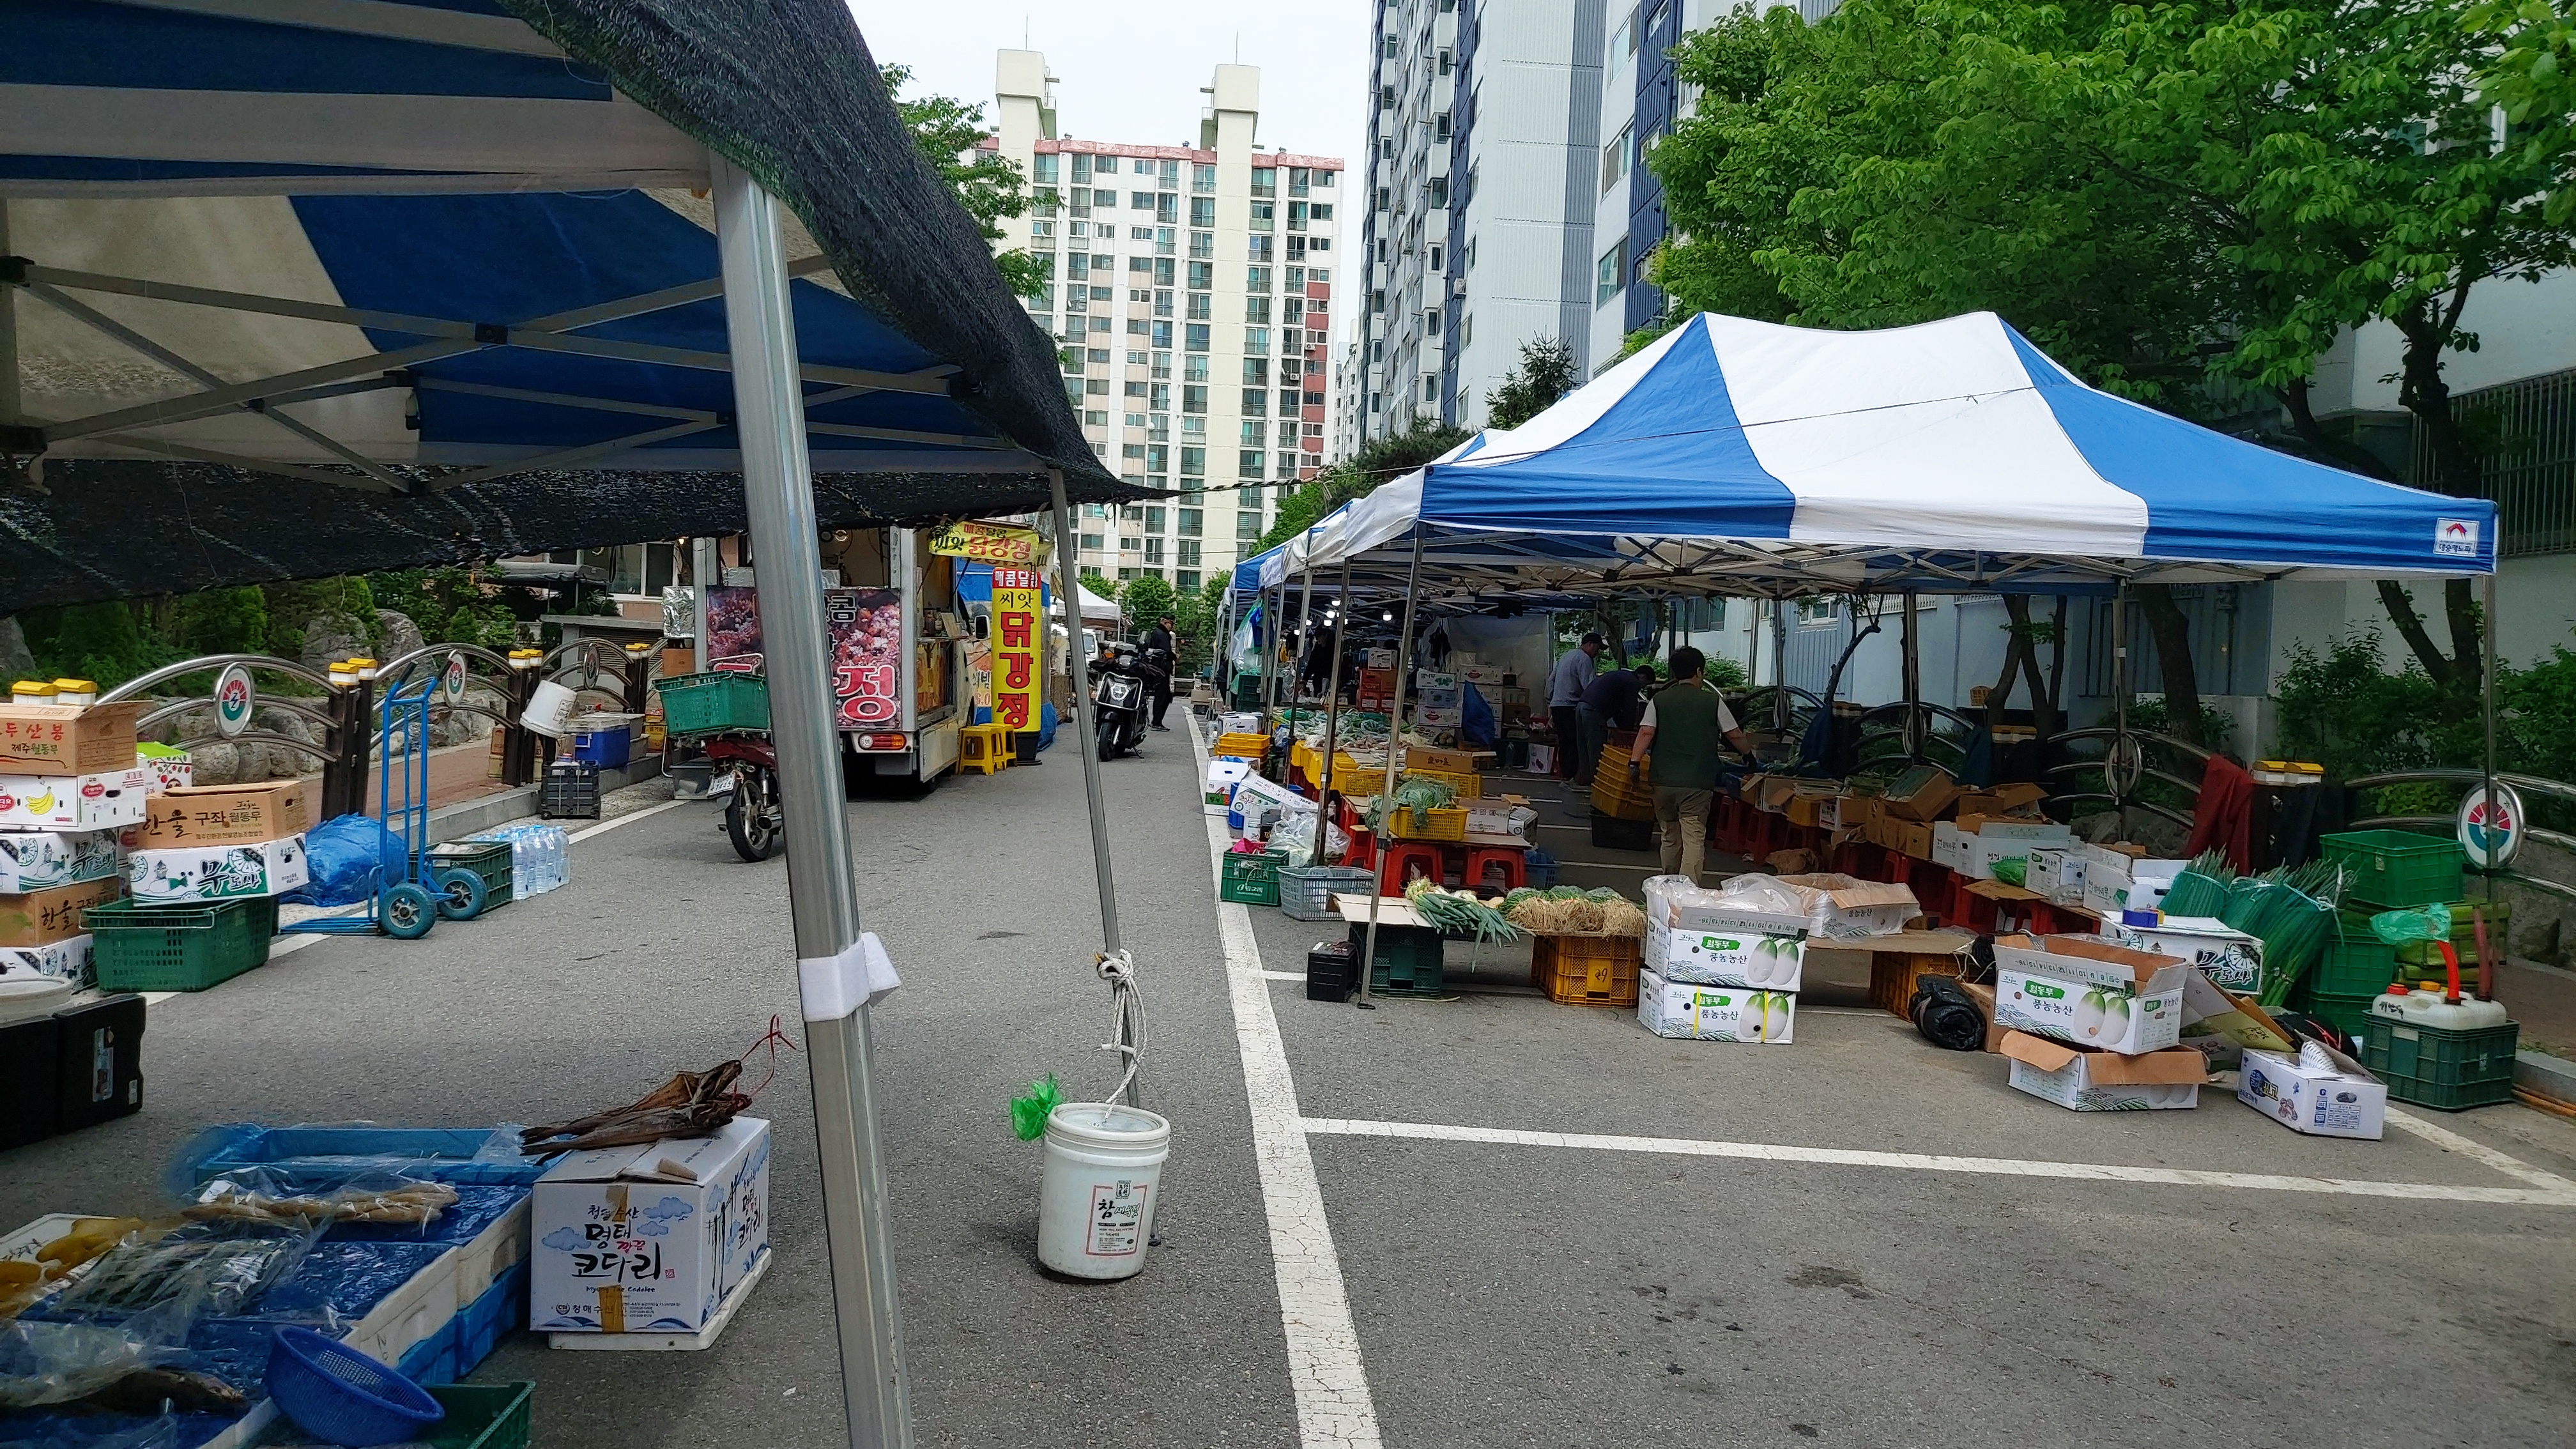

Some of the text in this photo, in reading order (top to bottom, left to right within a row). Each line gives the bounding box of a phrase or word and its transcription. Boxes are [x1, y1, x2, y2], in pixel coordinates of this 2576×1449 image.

[963, 524, 1007, 538] 매콤달콤
[969, 537, 1031, 560] 닭강정
[999, 591, 1034, 609] 씨앗
[997, 611, 1034, 729] 닭강정
[229, 811, 262, 823] 월동무
[1707, 939, 1729, 949] 월동무
[1709, 952, 1747, 964] 풍농농산
[2029, 984, 2053, 996] 월동무
[1701, 1009, 1738, 1021] 풍농농산
[2032, 998, 2073, 1016] 풍농농산
[1098, 1199, 1116, 1220] 참
[585, 1219, 631, 1250] 명태
[571, 1241, 661, 1284] 코다리
